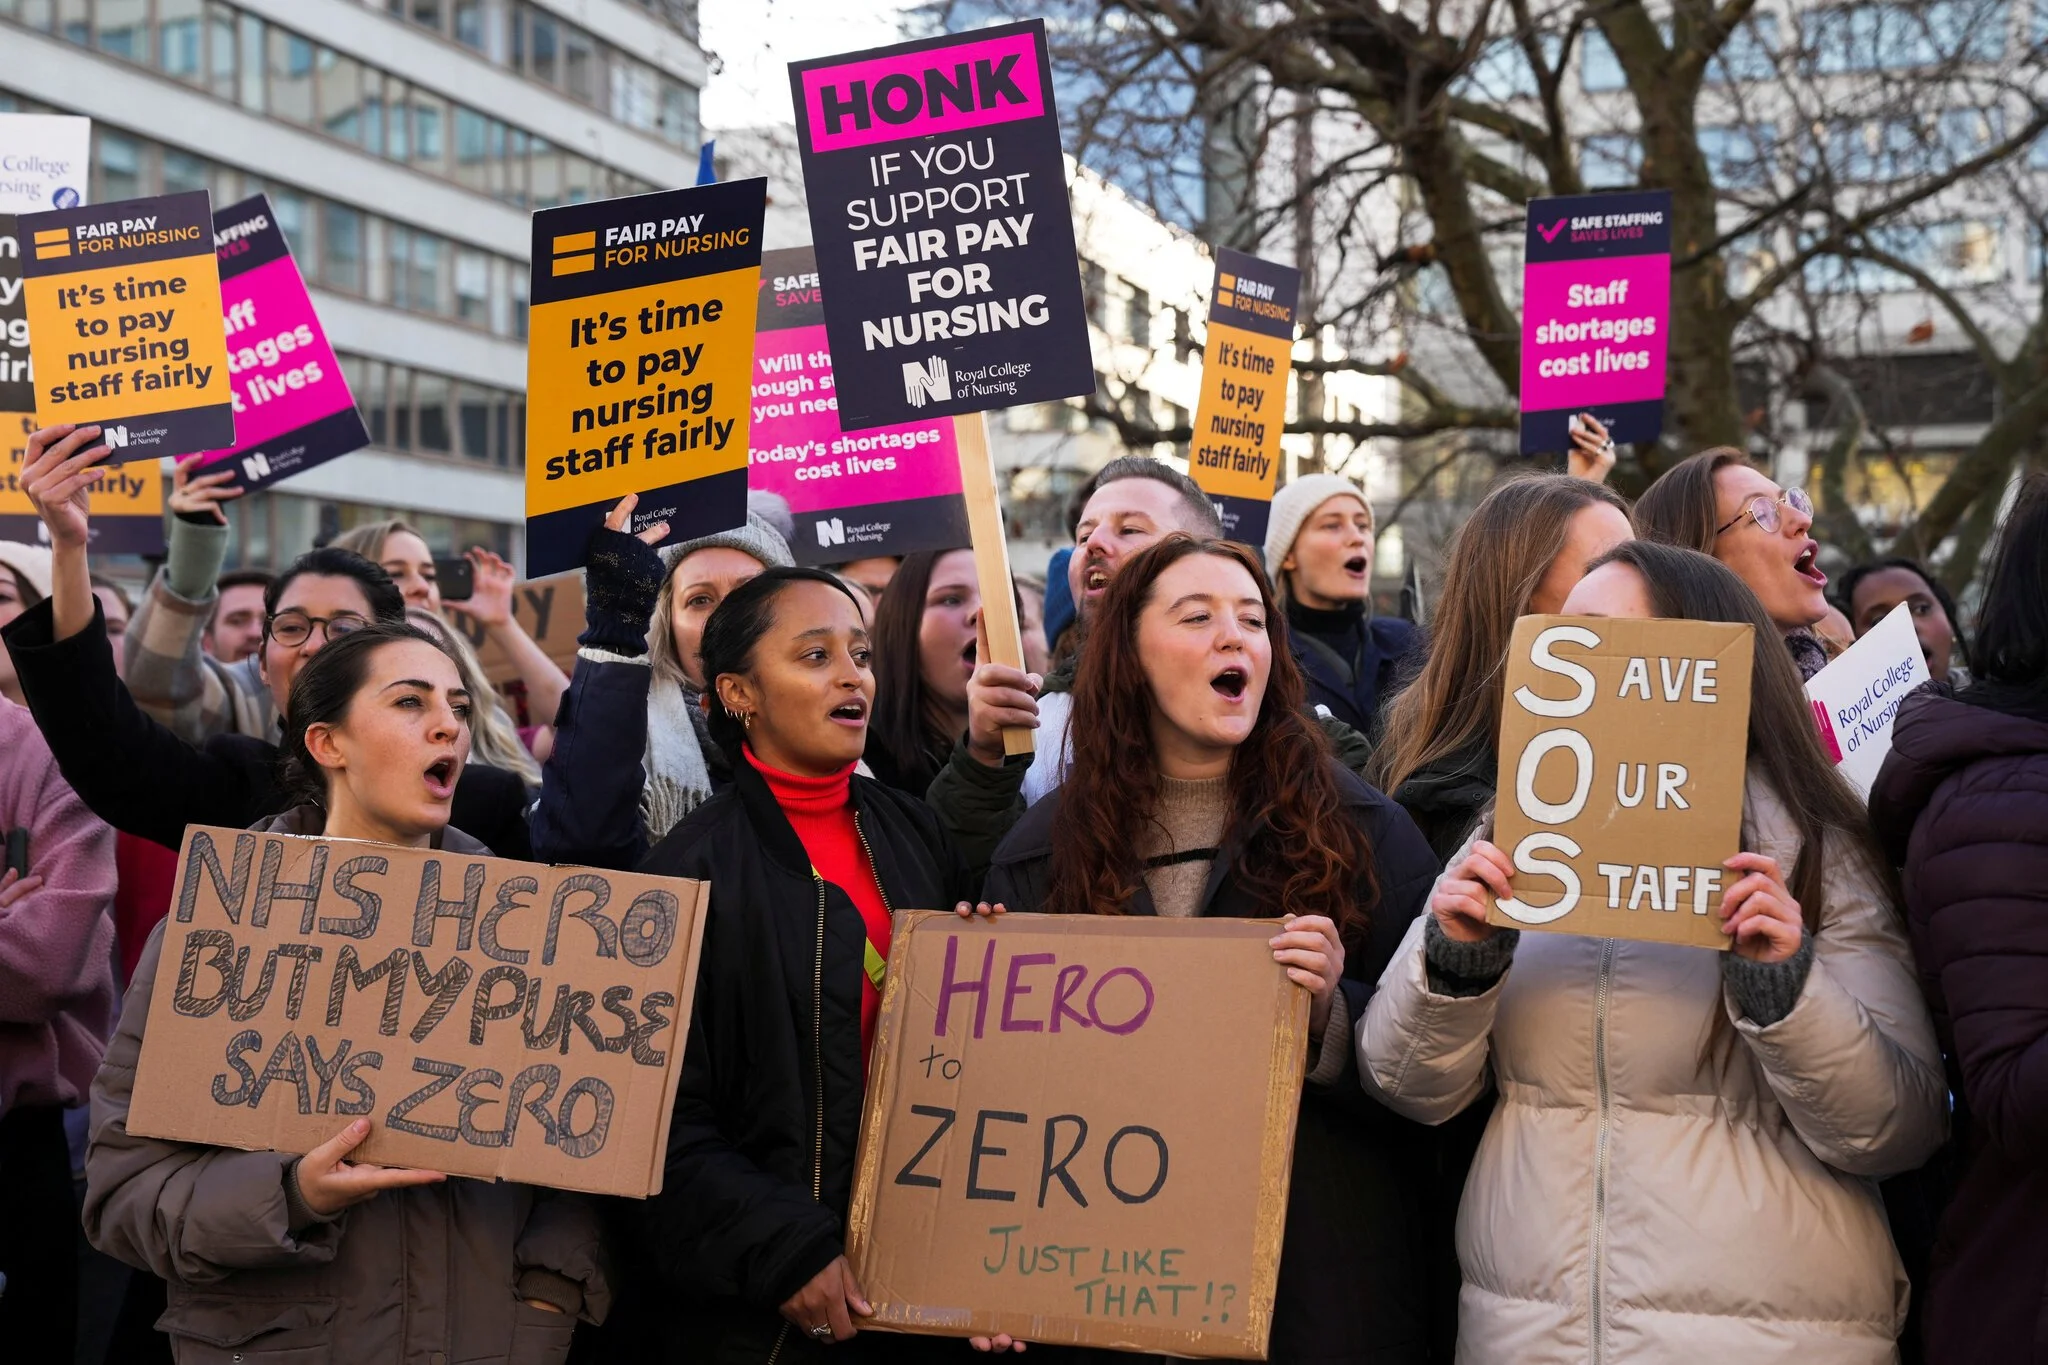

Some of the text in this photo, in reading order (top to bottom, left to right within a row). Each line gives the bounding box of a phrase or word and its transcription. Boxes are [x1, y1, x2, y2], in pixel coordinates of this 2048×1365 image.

[820, 53, 1029, 136] HONK
[3, 155, 70, 179] College
[870, 138, 995, 187] IF YOU
[847, 173, 1030, 231] SUPPORT
[76, 216, 157, 239] FAIR PAY
[605, 214, 704, 246] FAIR PAY
[1571, 212, 1663, 231] SAFE STAFFING
[1571, 226, 1644, 242] SAVES LIVES
[78, 226, 200, 254] FOR NURSING
[605, 228, 749, 269] FOR NURSING
[853, 213, 1034, 272] FAIR PAY
[113, 276, 187, 302] time
[773, 273, 820, 292] SAFE
[907, 263, 993, 304] FOR
[1237, 277, 1276, 301] FAIR PAY
[1567, 279, 1629, 308] Staff
[76, 309, 174, 337] to pay
[638, 298, 723, 335] time
[862, 294, 1050, 352] NURSING
[1234, 294, 1291, 322] FOR NURSING
[1536, 316, 1656, 345] shortages
[67, 337, 189, 371] nursing
[587, 343, 704, 387] to pay
[759, 353, 802, 375] Will
[1241, 346, 1275, 376] time
[1539, 347, 1650, 378] cost lives
[50, 363, 213, 403] staff fairly
[247, 360, 323, 406] lives
[955, 362, 1031, 385] Royal College
[957, 381, 1017, 399] of Nursing
[1221, 378, 1264, 412] to pay
[572, 382, 713, 433] nursing
[753, 402, 795, 423] you
[146, 428, 168, 436] College
[831, 428, 940, 455] shortages
[1211, 414, 1264, 447] nursing
[545, 417, 735, 481] staff fairly
[1197, 447, 1271, 481] staff fairly
[795, 455, 896, 481] cost lives
[634, 507, 677, 523] Royal College
[634, 523, 642, 532] of
[1838, 656, 1914, 728] Royal College
[1847, 728, 1861, 752] of
[176, 831, 679, 967] NHS HERO
[174, 929, 674, 1067] BUT MY PURSE
[934, 935, 1154, 1039] HERO
[920, 1044, 961, 1080] to
[211, 1029, 615, 1158] SAYS ZERO
[894, 1104, 1169, 1208] ZERO
[983, 1225, 1185, 1278] JUST LIKE
